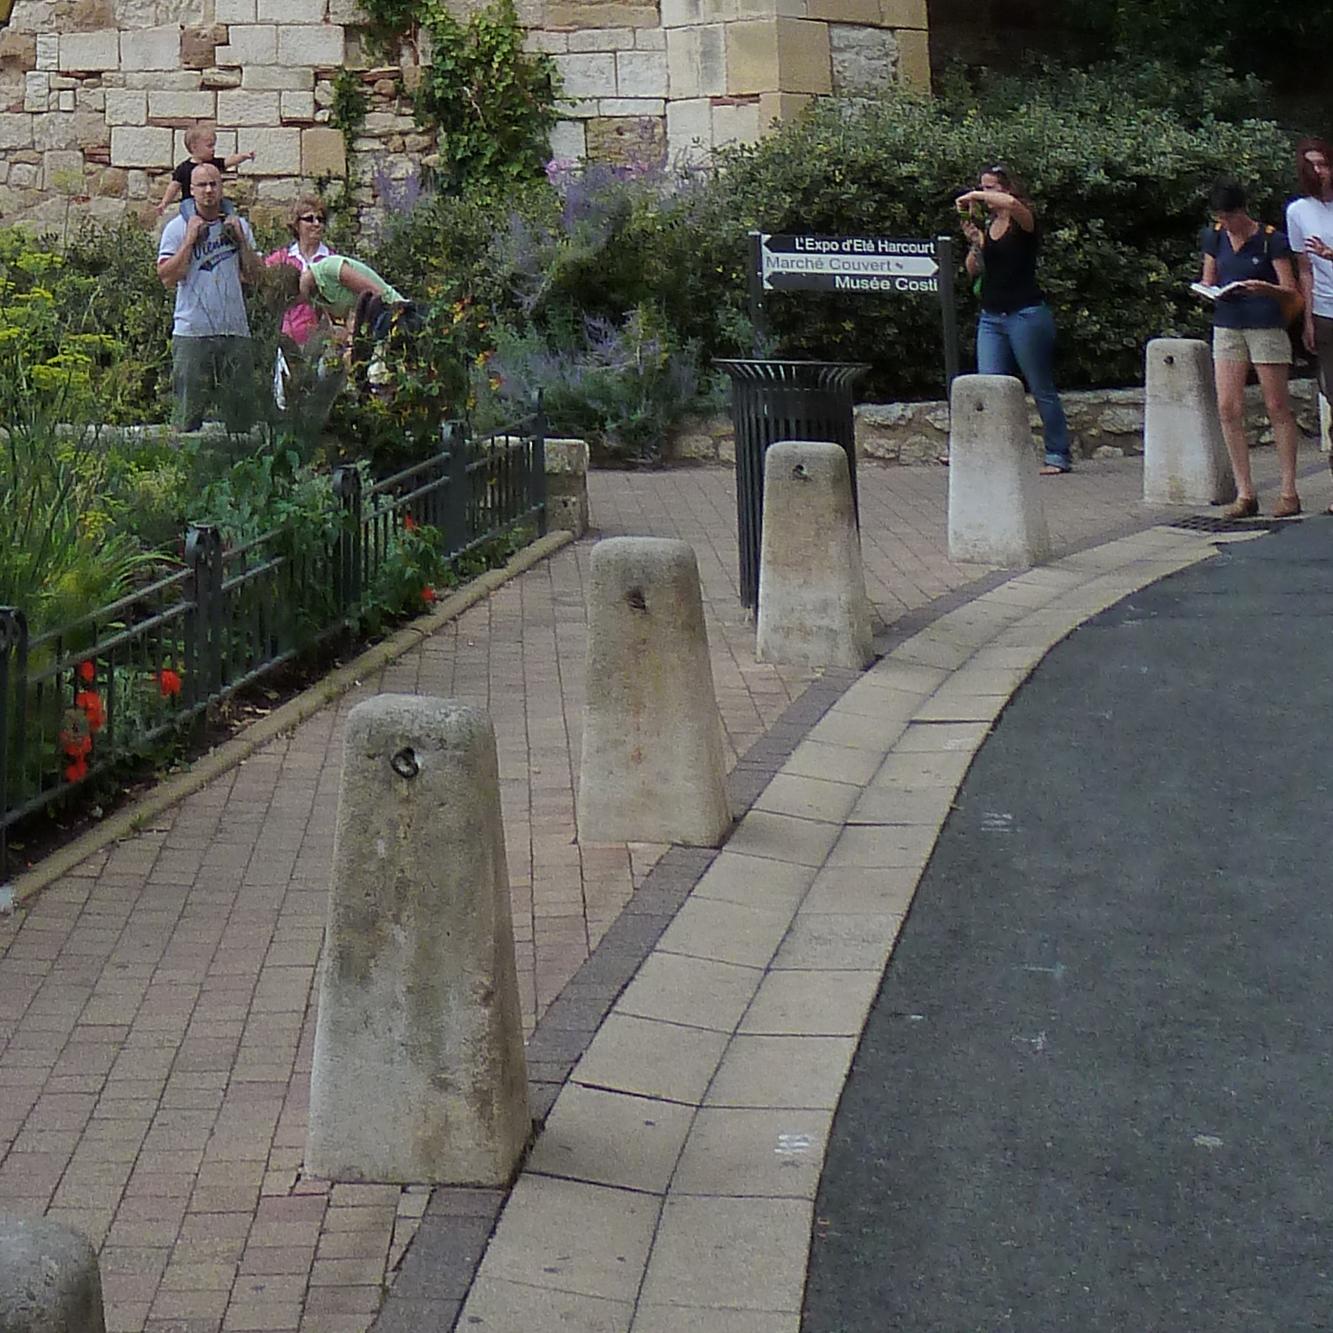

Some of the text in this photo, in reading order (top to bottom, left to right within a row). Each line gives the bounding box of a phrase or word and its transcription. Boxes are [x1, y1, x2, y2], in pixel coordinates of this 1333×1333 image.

[795, 237, 840, 253] L'Expo
[878, 239, 936, 254] Harcourt
[766, 256, 893, 271] Marché Couvert
[835, 276, 938, 291] Musée Costi
